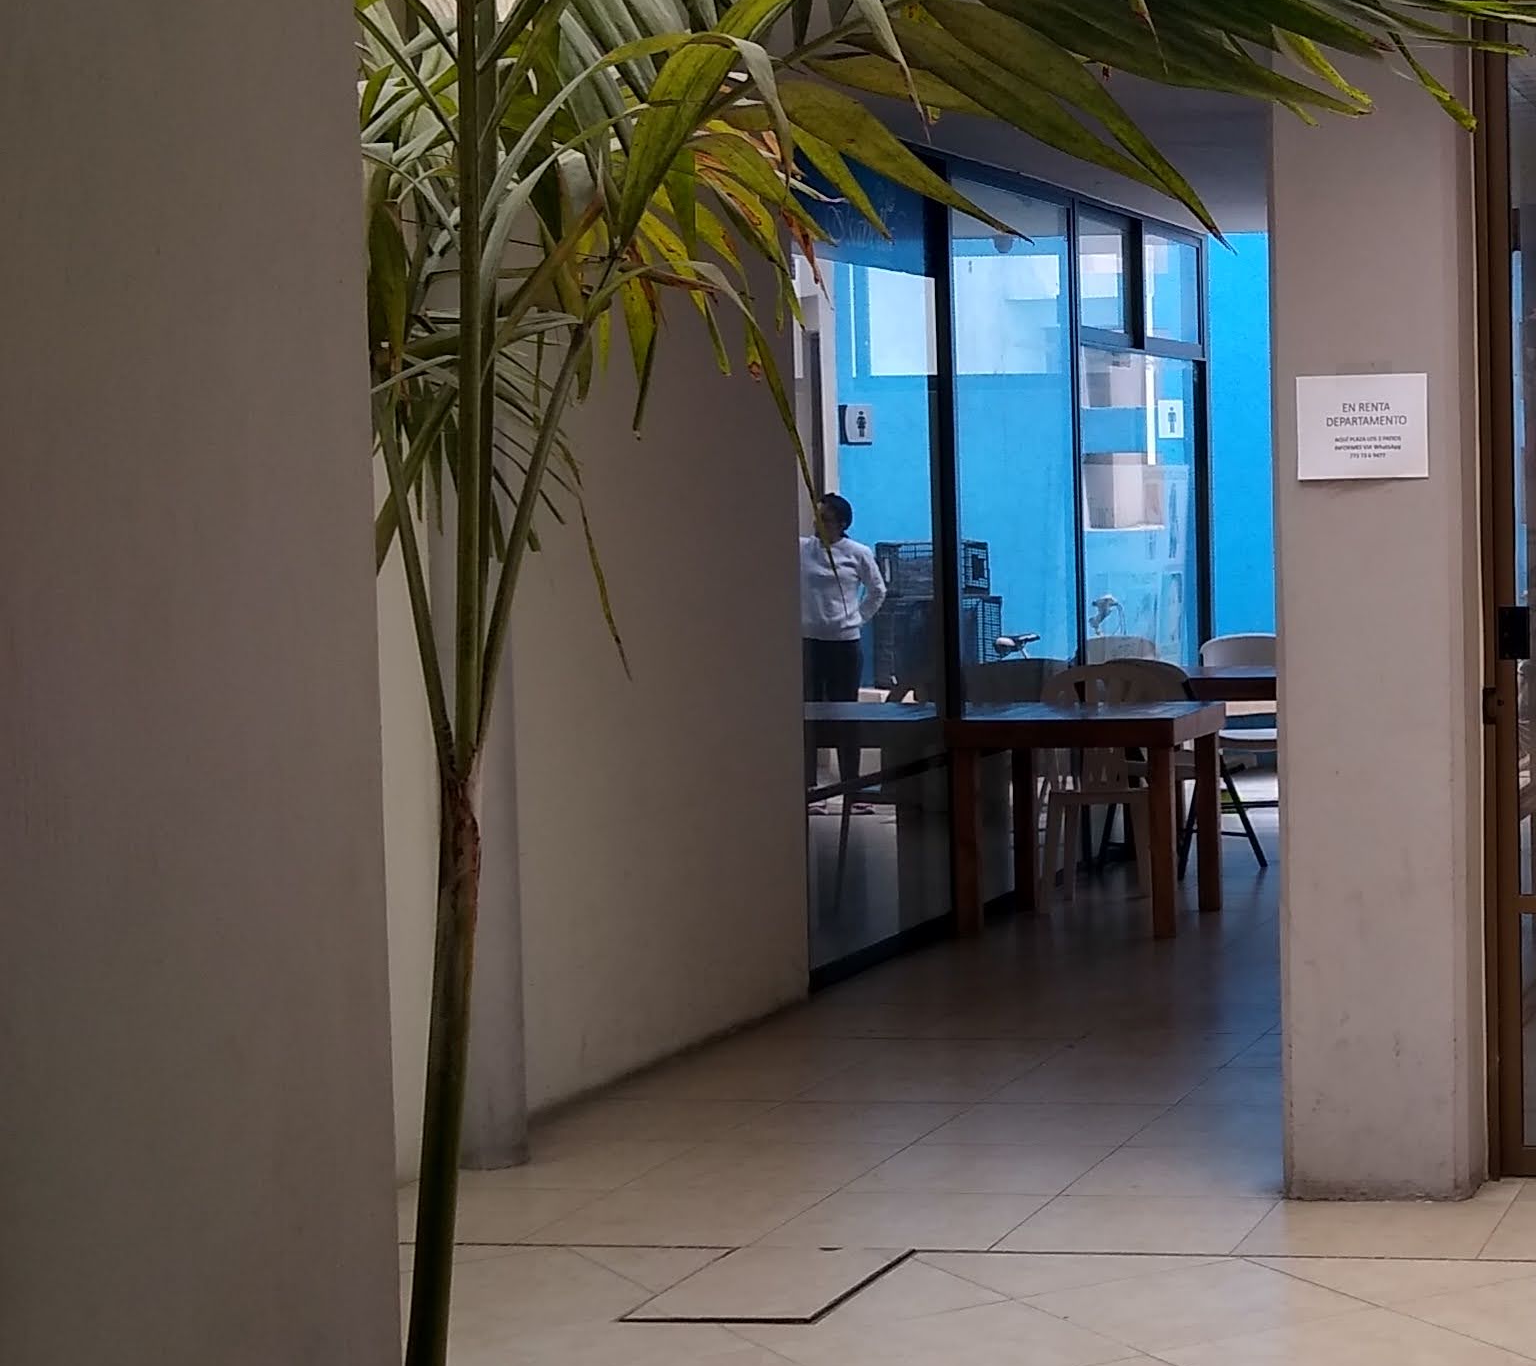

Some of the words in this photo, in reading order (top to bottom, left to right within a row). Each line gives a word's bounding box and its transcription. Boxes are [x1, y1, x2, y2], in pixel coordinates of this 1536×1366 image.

[1342, 402, 1356, 413] EN
[1358, 401, 1391, 412] RENTA
[1325, 415, 1408, 427] DEPARTAMENTO
